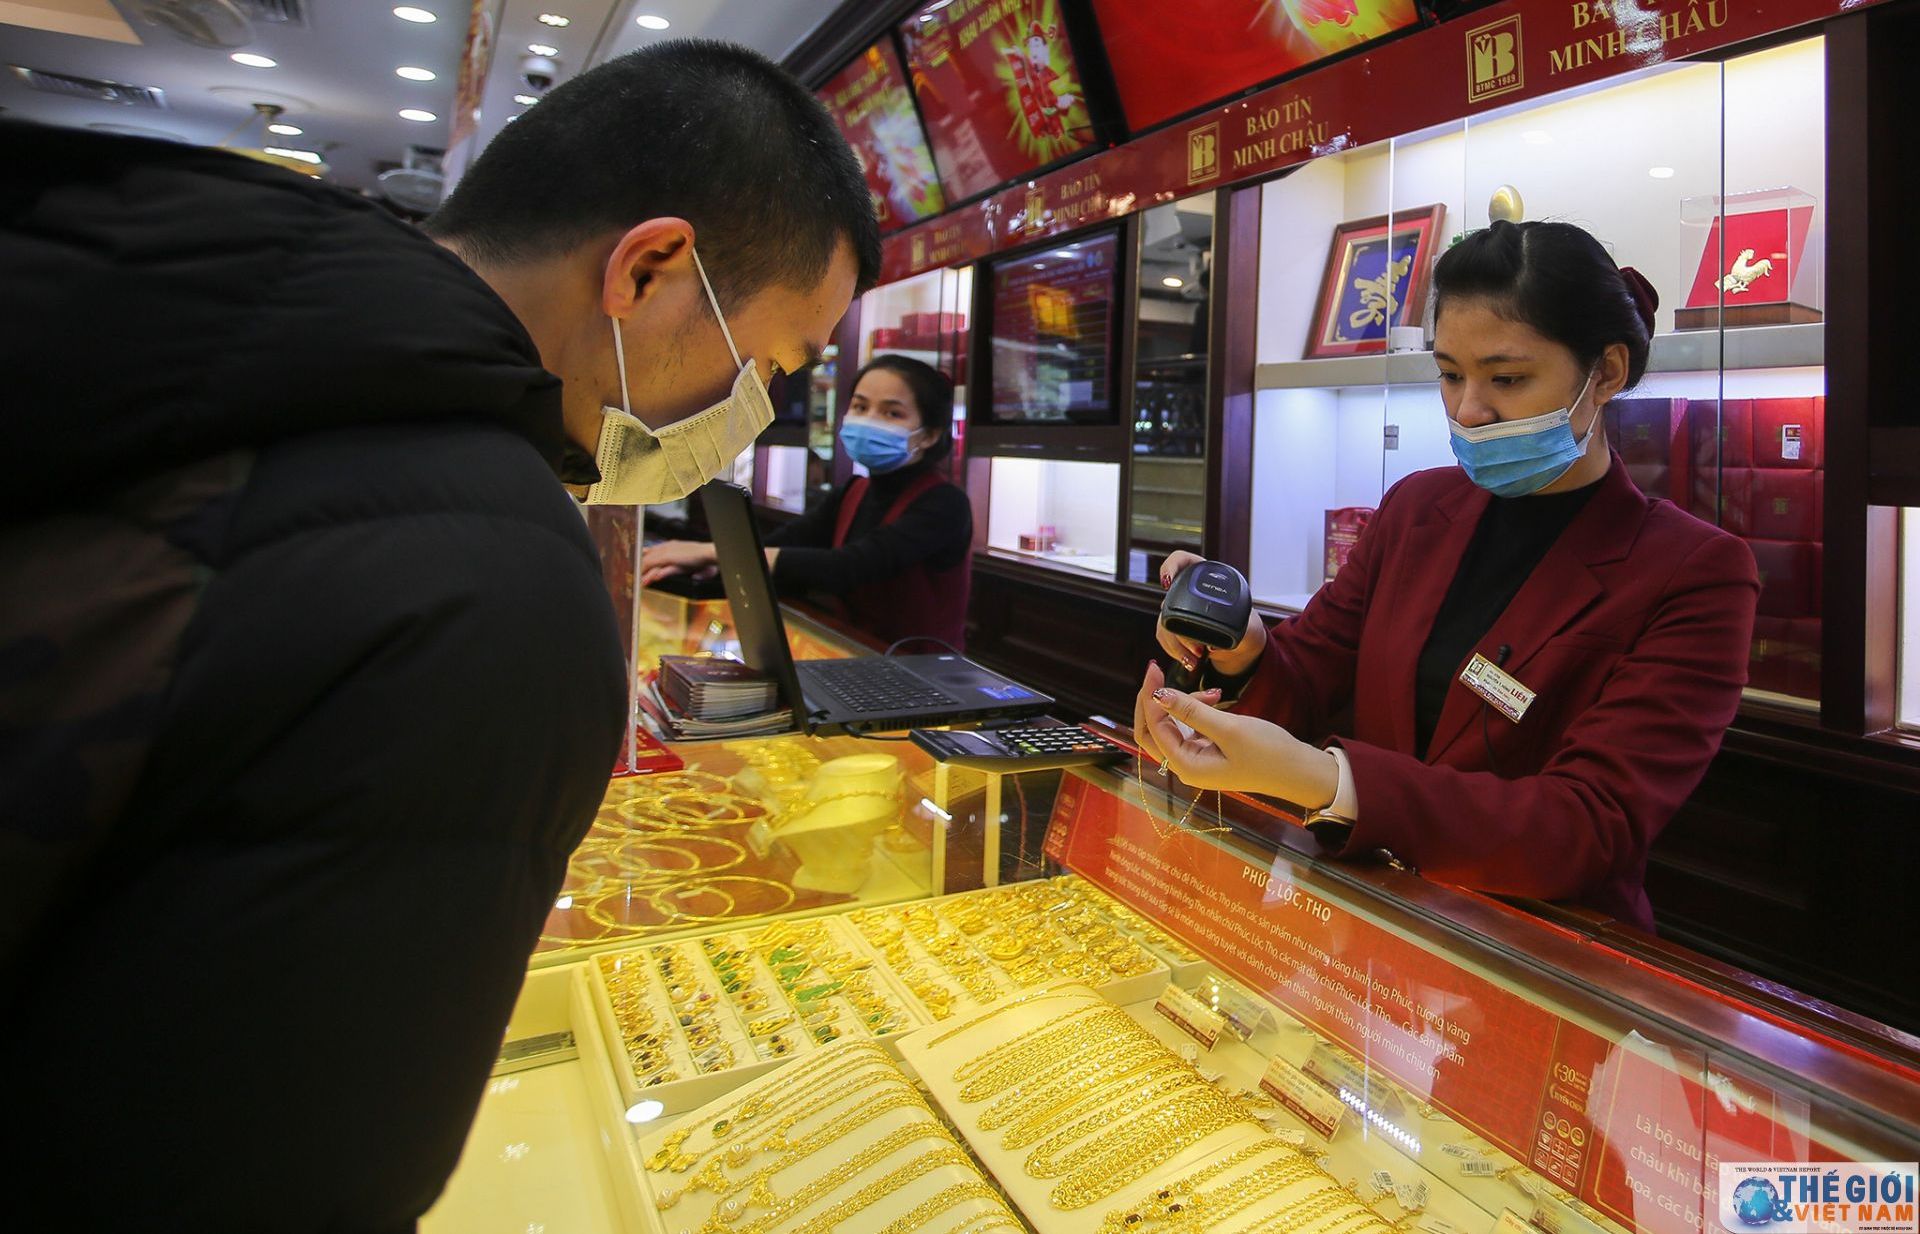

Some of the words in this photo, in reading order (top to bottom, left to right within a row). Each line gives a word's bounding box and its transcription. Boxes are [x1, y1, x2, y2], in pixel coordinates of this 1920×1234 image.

[1550, 29, 1627, 75] MINH
[1475, 80, 1497, 93] BTMC
[1498, 74, 1516, 87] 1989
[1283, 95, 1312, 123] TÍN
[1233, 138, 1275, 169] MINH
[1279, 120, 1329, 154] CHÂU
[1242, 865, 1275, 895] PHÚC,
[1277, 883, 1303, 910] LỘC,
[1305, 897, 1331, 925] THỌ
[1270, 923, 1291, 941] phẩm
[1292, 935, 1308, 951] như
[1308, 944, 1330, 966] tượng
[1331, 957, 1351, 978] vàng
[1352, 966, 1371, 988] hình
[1371, 978, 1390, 999] ông
[1390, 988, 1414, 1013] Phúc,
[1416, 1003, 1444, 1030] tượng
[1446, 1021, 1471, 1045] vàng
[1246, 953, 1264, 973] dành
[1264, 965, 1278, 980] cho
[1291, 980, 1310, 1001] thân,
[1312, 994, 1336, 1015] người
[1335, 1008, 1355, 1029] thân,
[1356, 1021, 1381, 1042] người
[1382, 1036, 1405, 1060] mình
[1406, 1051, 1426, 1072] chịu
[1427, 1065, 1440, 1081] ơn
[1279, 951, 1291, 967] các
[1435, 1041, 1465, 1067] phẩm
[1635, 1113, 1652, 1135] Là
[1654, 1122, 1673, 1149] bộ
[1676, 1138, 1702, 1162] sưu
[1630, 1145, 1663, 1175] châu
[1667, 1161, 1690, 1188] khi
[1657, 1193, 1682, 1217] các
[1684, 1205, 1704, 1232] bộ
